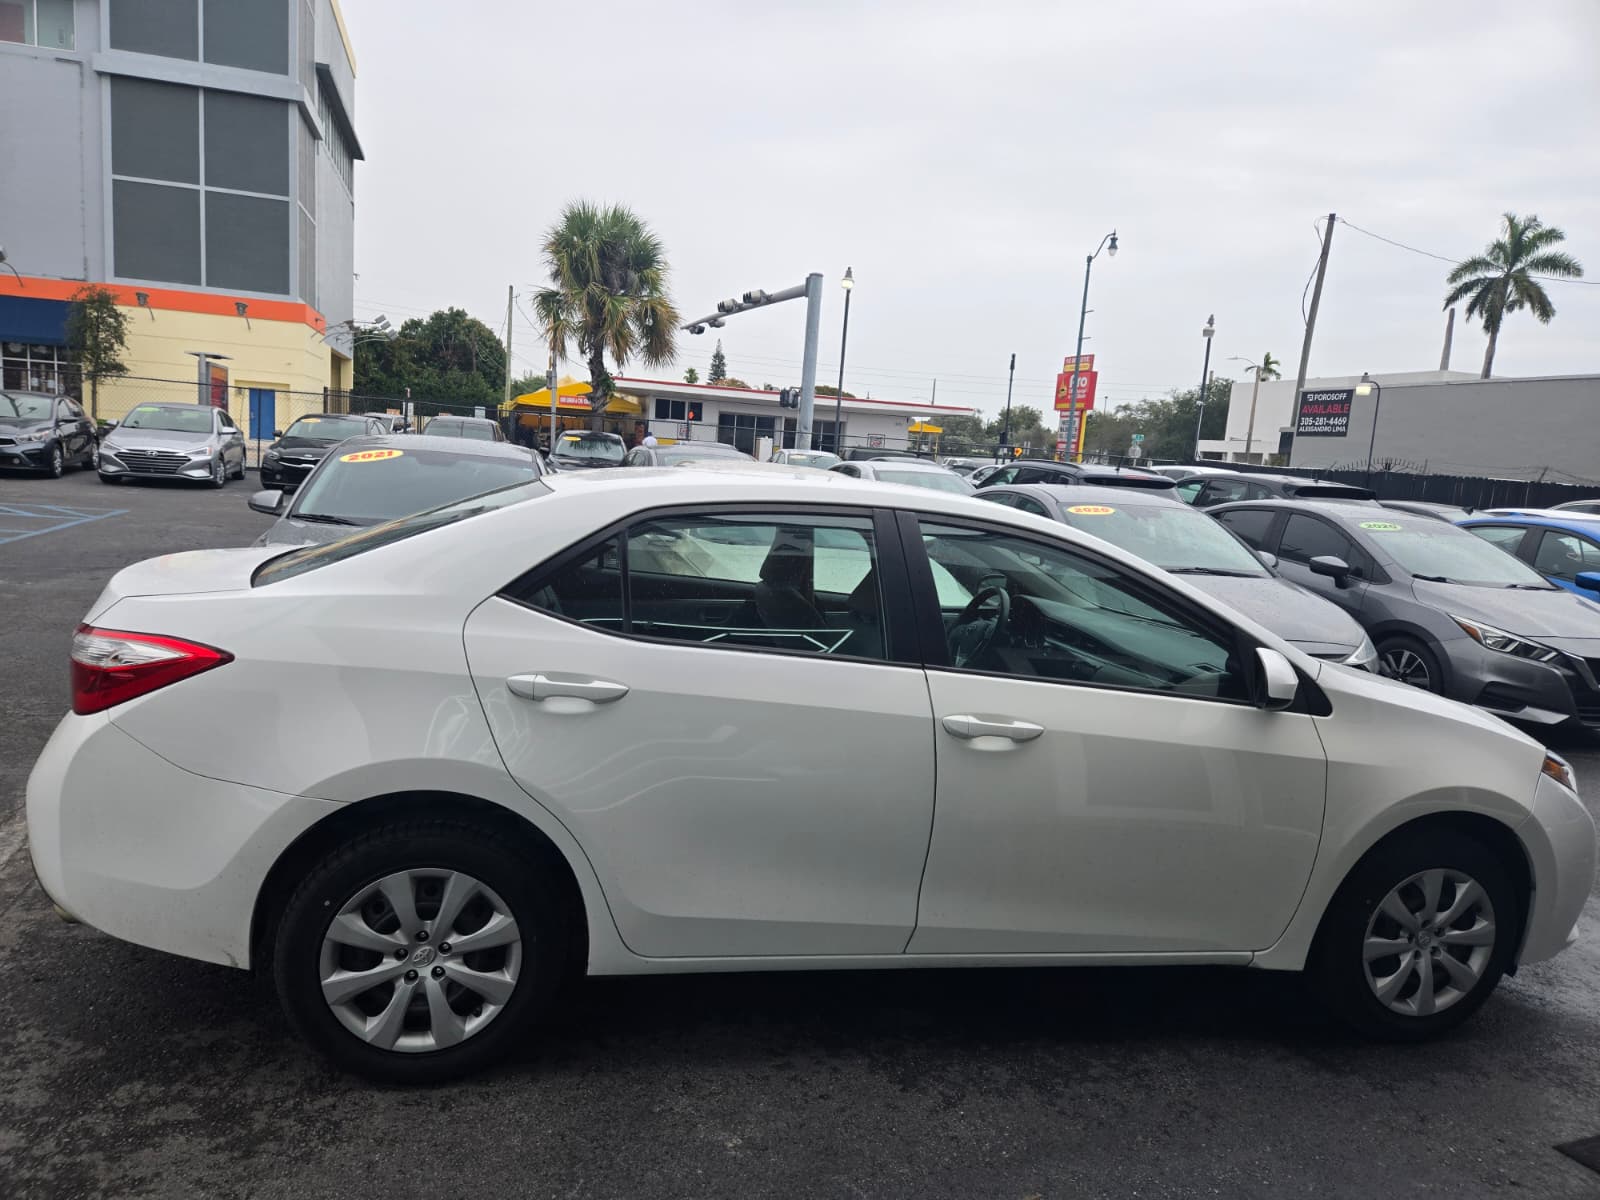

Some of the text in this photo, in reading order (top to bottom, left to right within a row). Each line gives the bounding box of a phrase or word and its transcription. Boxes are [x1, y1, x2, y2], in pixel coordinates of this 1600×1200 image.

[1302, 404, 1350, 413] AVAILABLE
[1300, 417, 1347, 425] 305-281-4469
[348, 450, 393, 461] 2021
